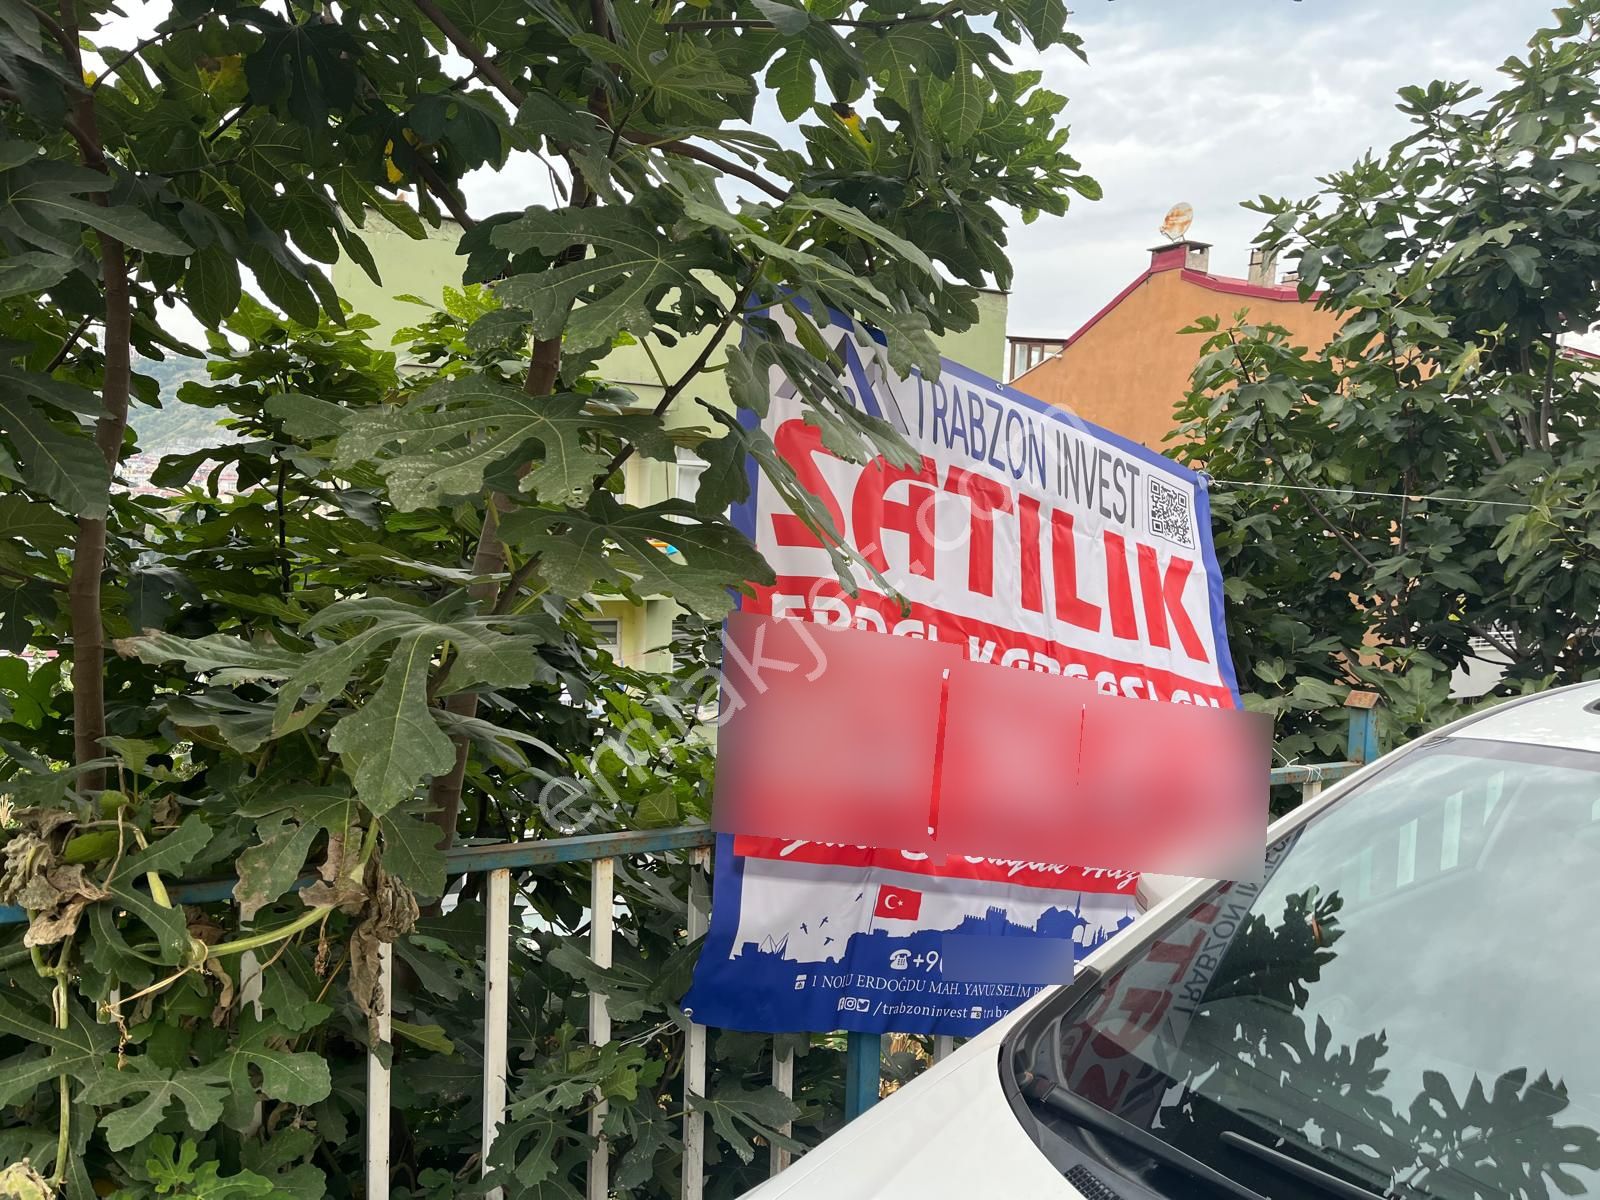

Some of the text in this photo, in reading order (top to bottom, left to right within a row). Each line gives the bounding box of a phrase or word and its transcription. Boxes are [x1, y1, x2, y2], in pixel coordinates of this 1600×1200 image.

[910, 367, 1141, 529] TRABZON INVEST
[770, 418, 1210, 664] SATILIK
[856, 975, 926, 992] ERDOĞDU
[928, 981, 961, 996] MAH.
